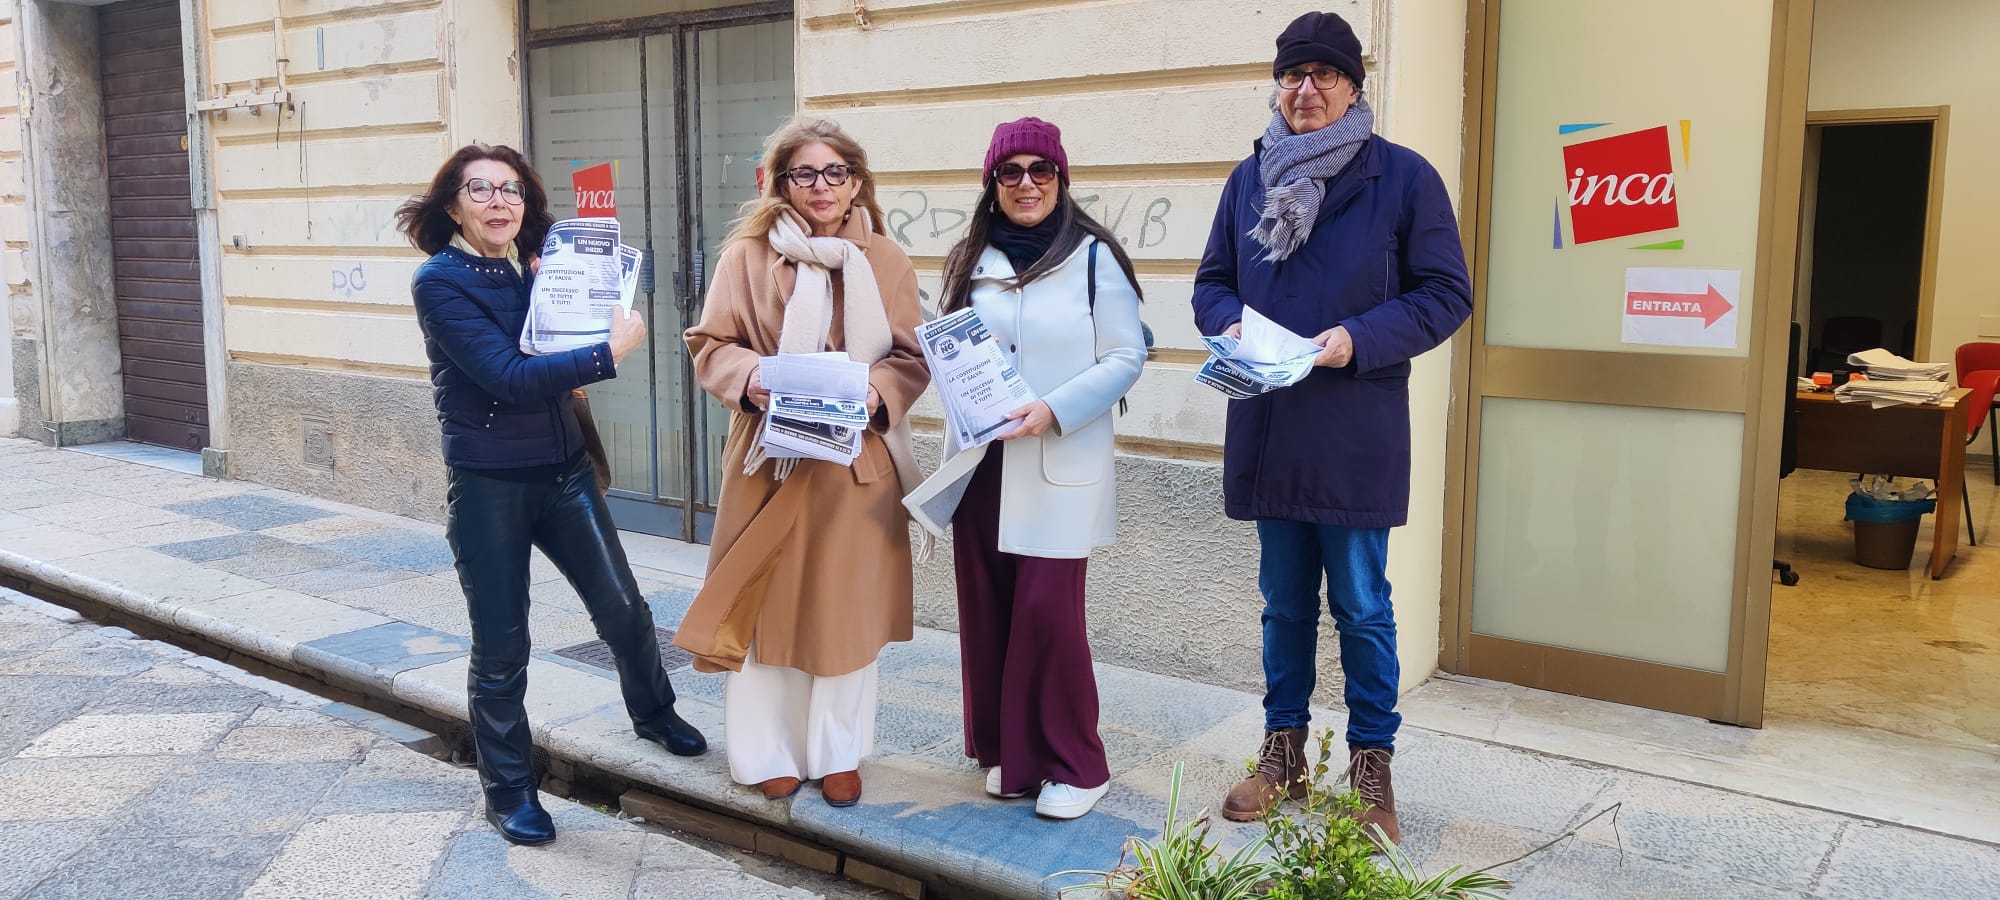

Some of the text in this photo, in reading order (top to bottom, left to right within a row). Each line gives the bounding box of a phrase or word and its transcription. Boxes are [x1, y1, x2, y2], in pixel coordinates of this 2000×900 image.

[1568, 167, 1675, 207] inca
[576, 186, 616, 208] inca
[1632, 300, 1702, 313] ENTRATA
[940, 342, 955, 354] NO
[1215, 364, 1239, 377] NUOVO
[969, 378, 994, 393] SUCCESSO
[977, 386, 992, 396] TUTTE
[978, 392, 993, 403] TUTTI
[835, 425, 849, 433] NO
